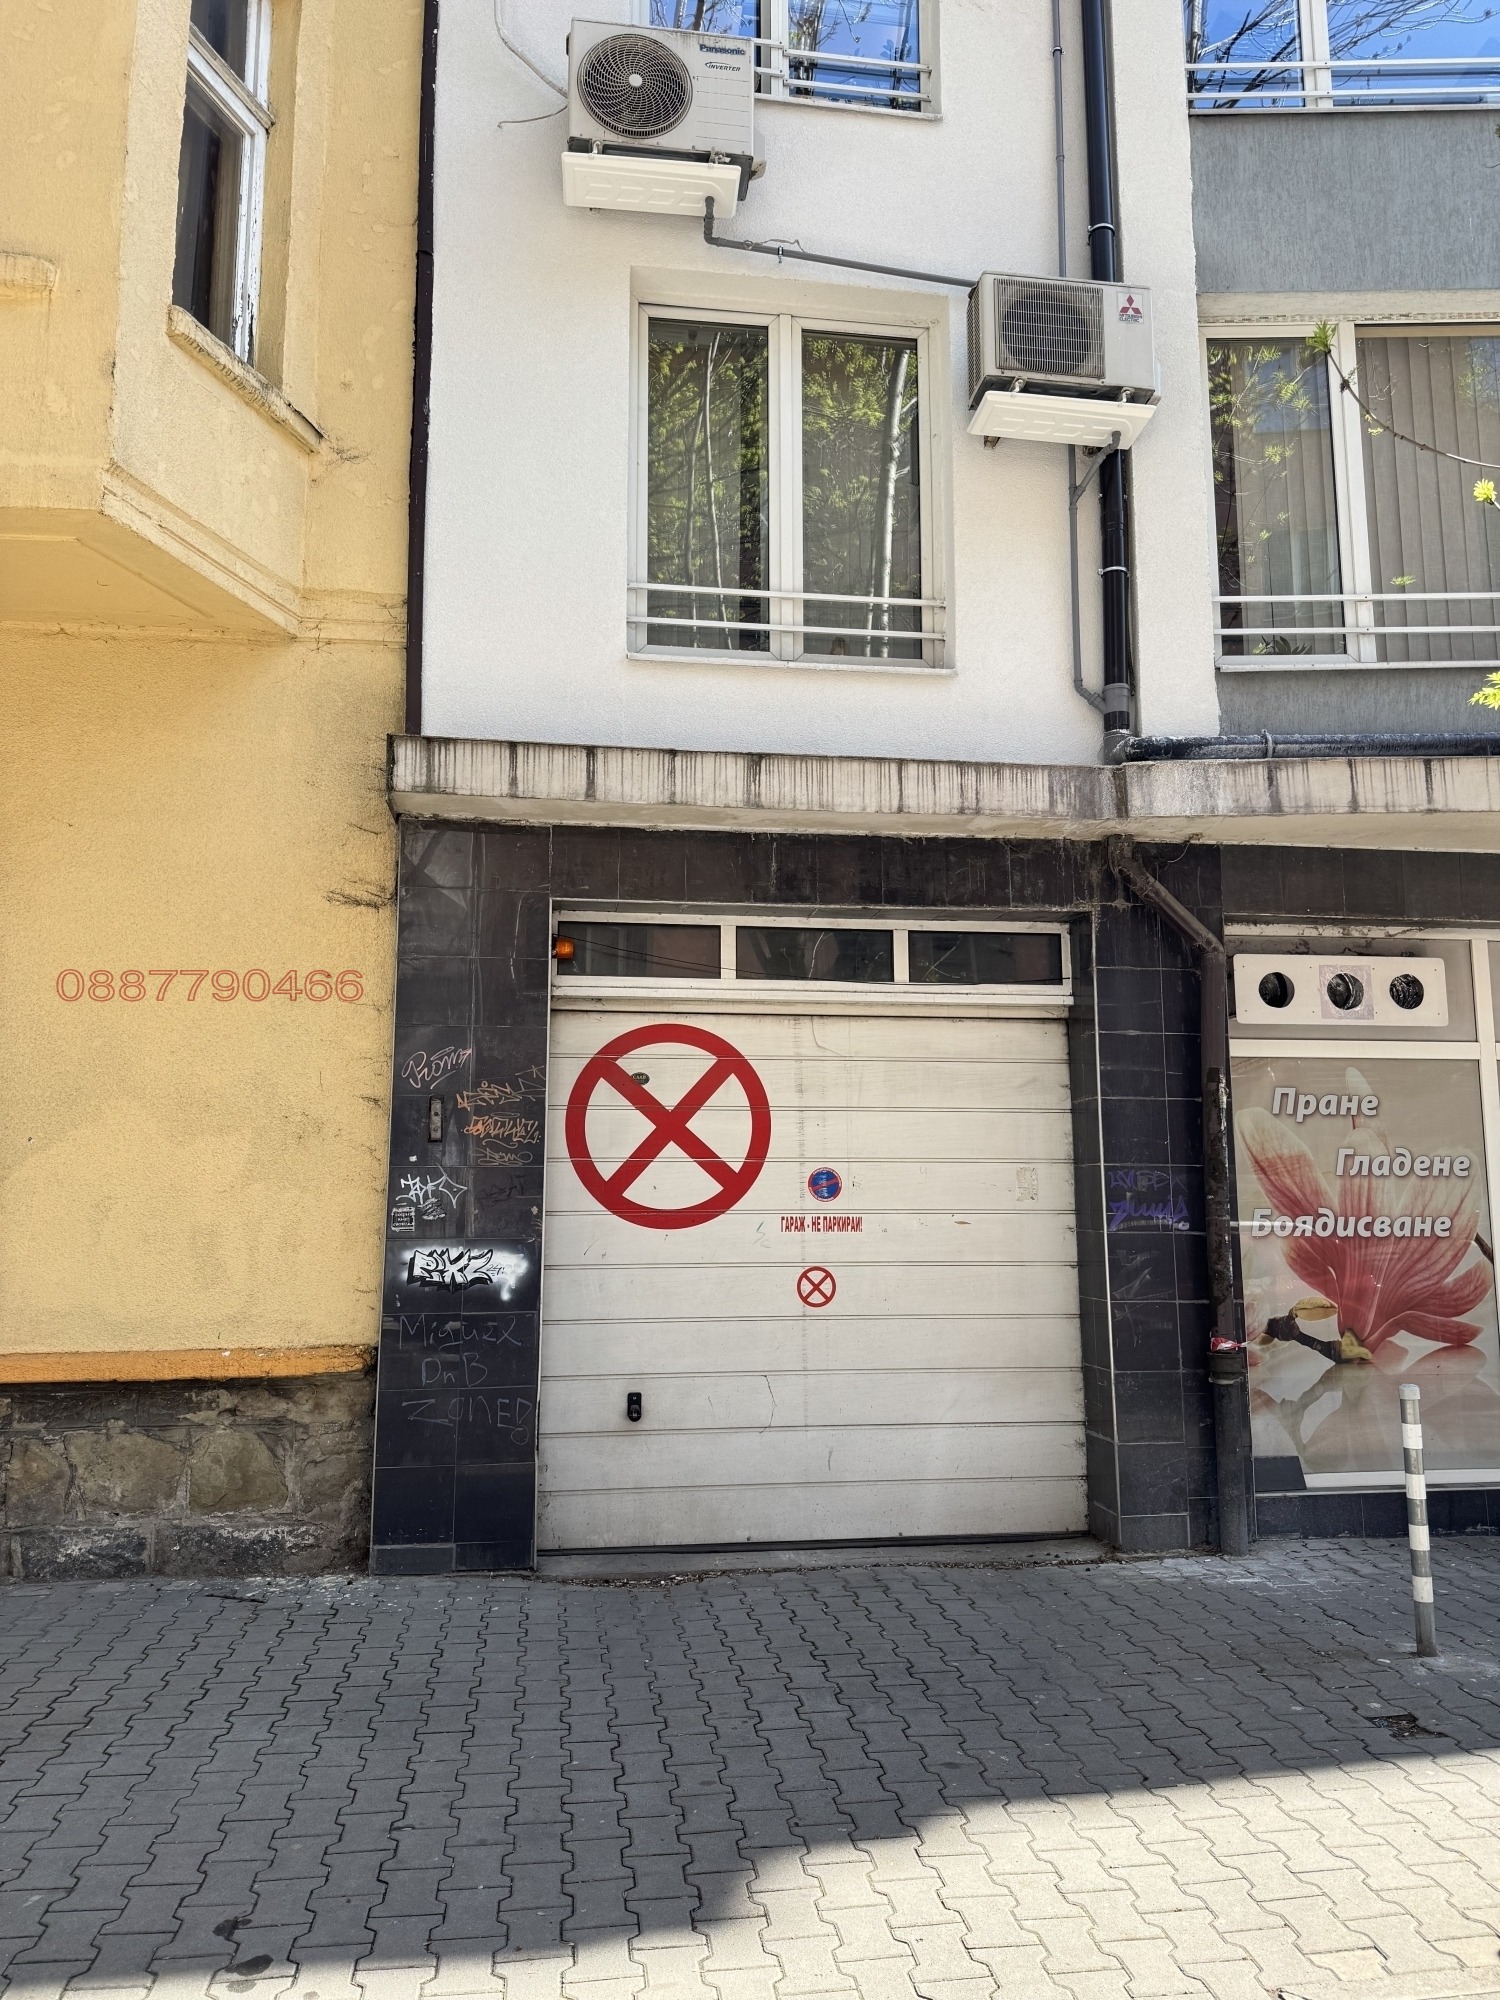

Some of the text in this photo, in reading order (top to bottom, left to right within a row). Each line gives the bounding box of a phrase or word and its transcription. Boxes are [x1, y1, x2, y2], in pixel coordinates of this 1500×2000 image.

[700, 43, 746, 56] Panasonic
[56, 968, 364, 1002] 0887790466
[1272, 1087, 1379, 1123] Пране
[1336, 1148, 1471, 1177] Гладене
[780, 1216, 806, 1233] ГАРАЖ
[811, 1216, 821, 1233] НЕ
[1251, 1207, 1453, 1238] Боядисване
